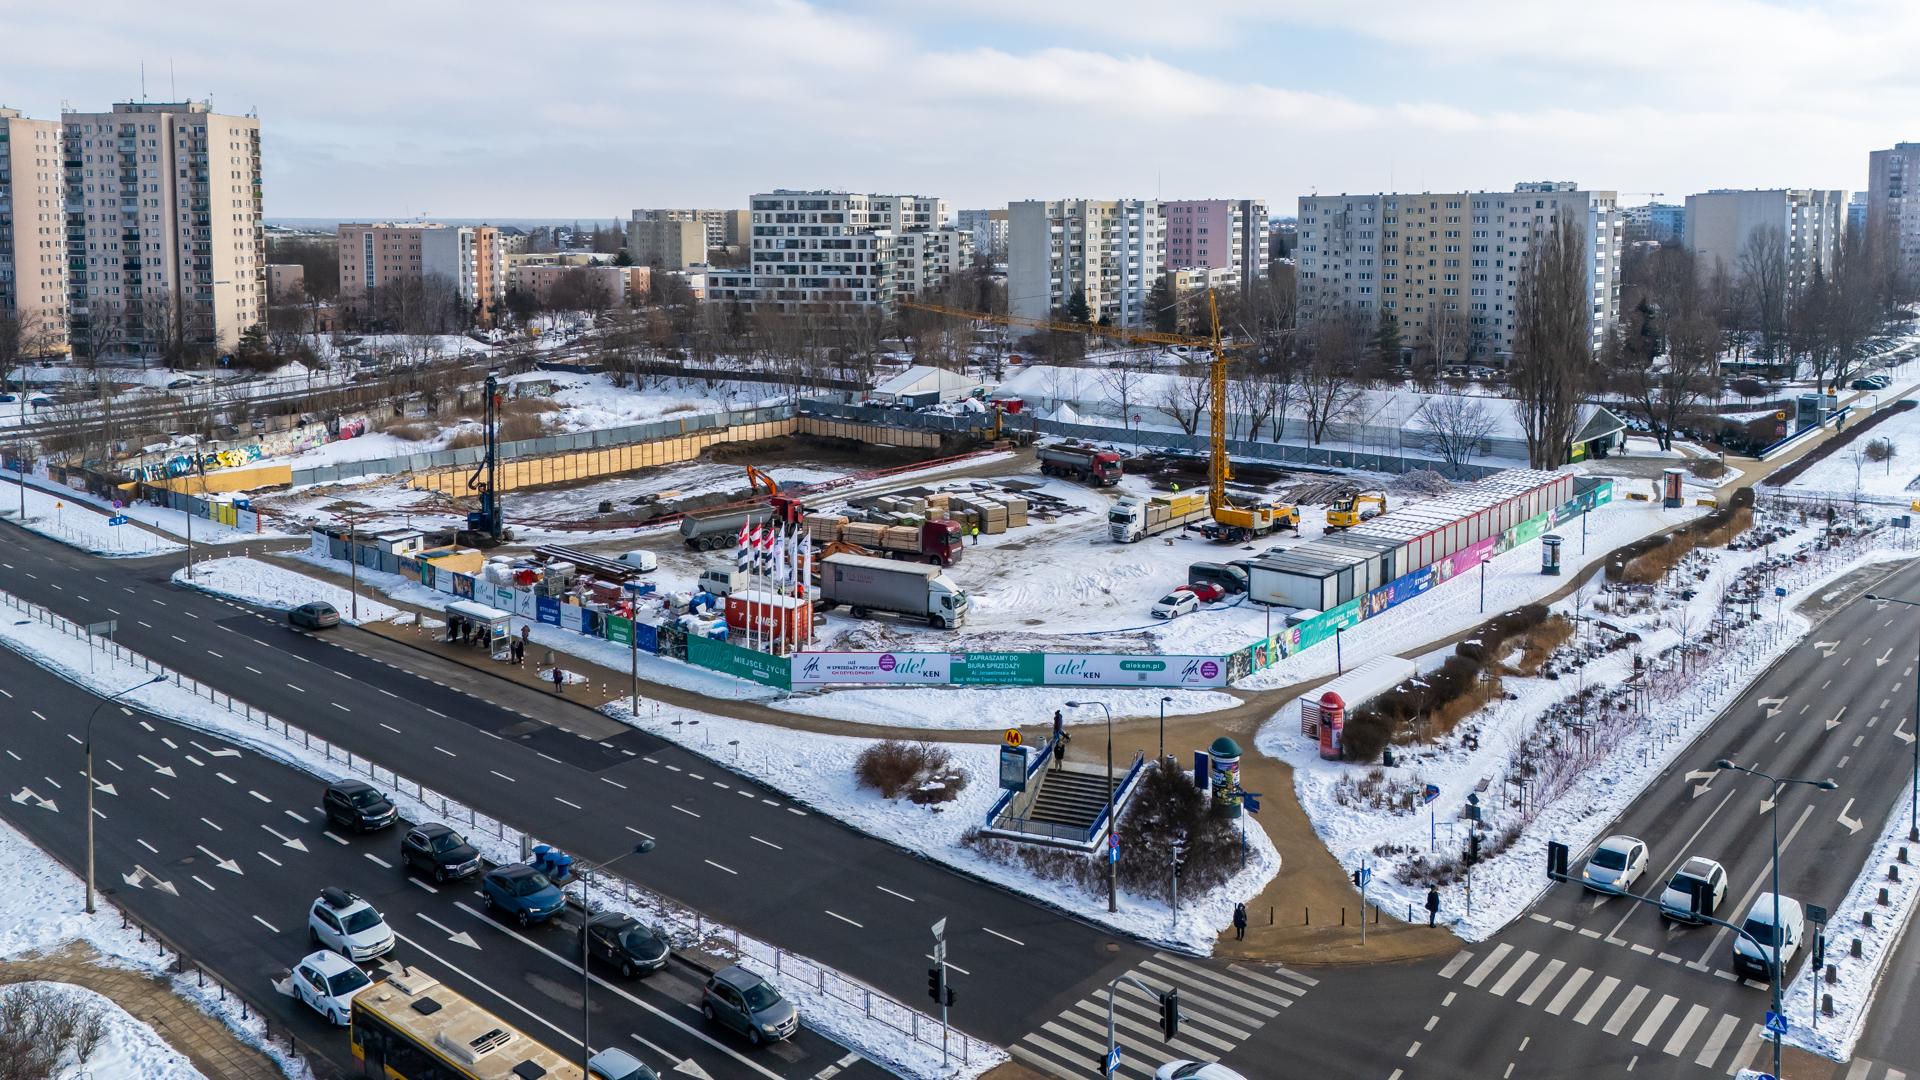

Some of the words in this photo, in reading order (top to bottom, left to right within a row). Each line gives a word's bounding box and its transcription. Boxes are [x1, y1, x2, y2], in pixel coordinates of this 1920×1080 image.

[894, 657, 926, 674] ale!
[1054, 659, 1086, 675] ale!
[1125, 662, 1160, 670] aleken.pl
[1007, 731, 1019, 743] M
